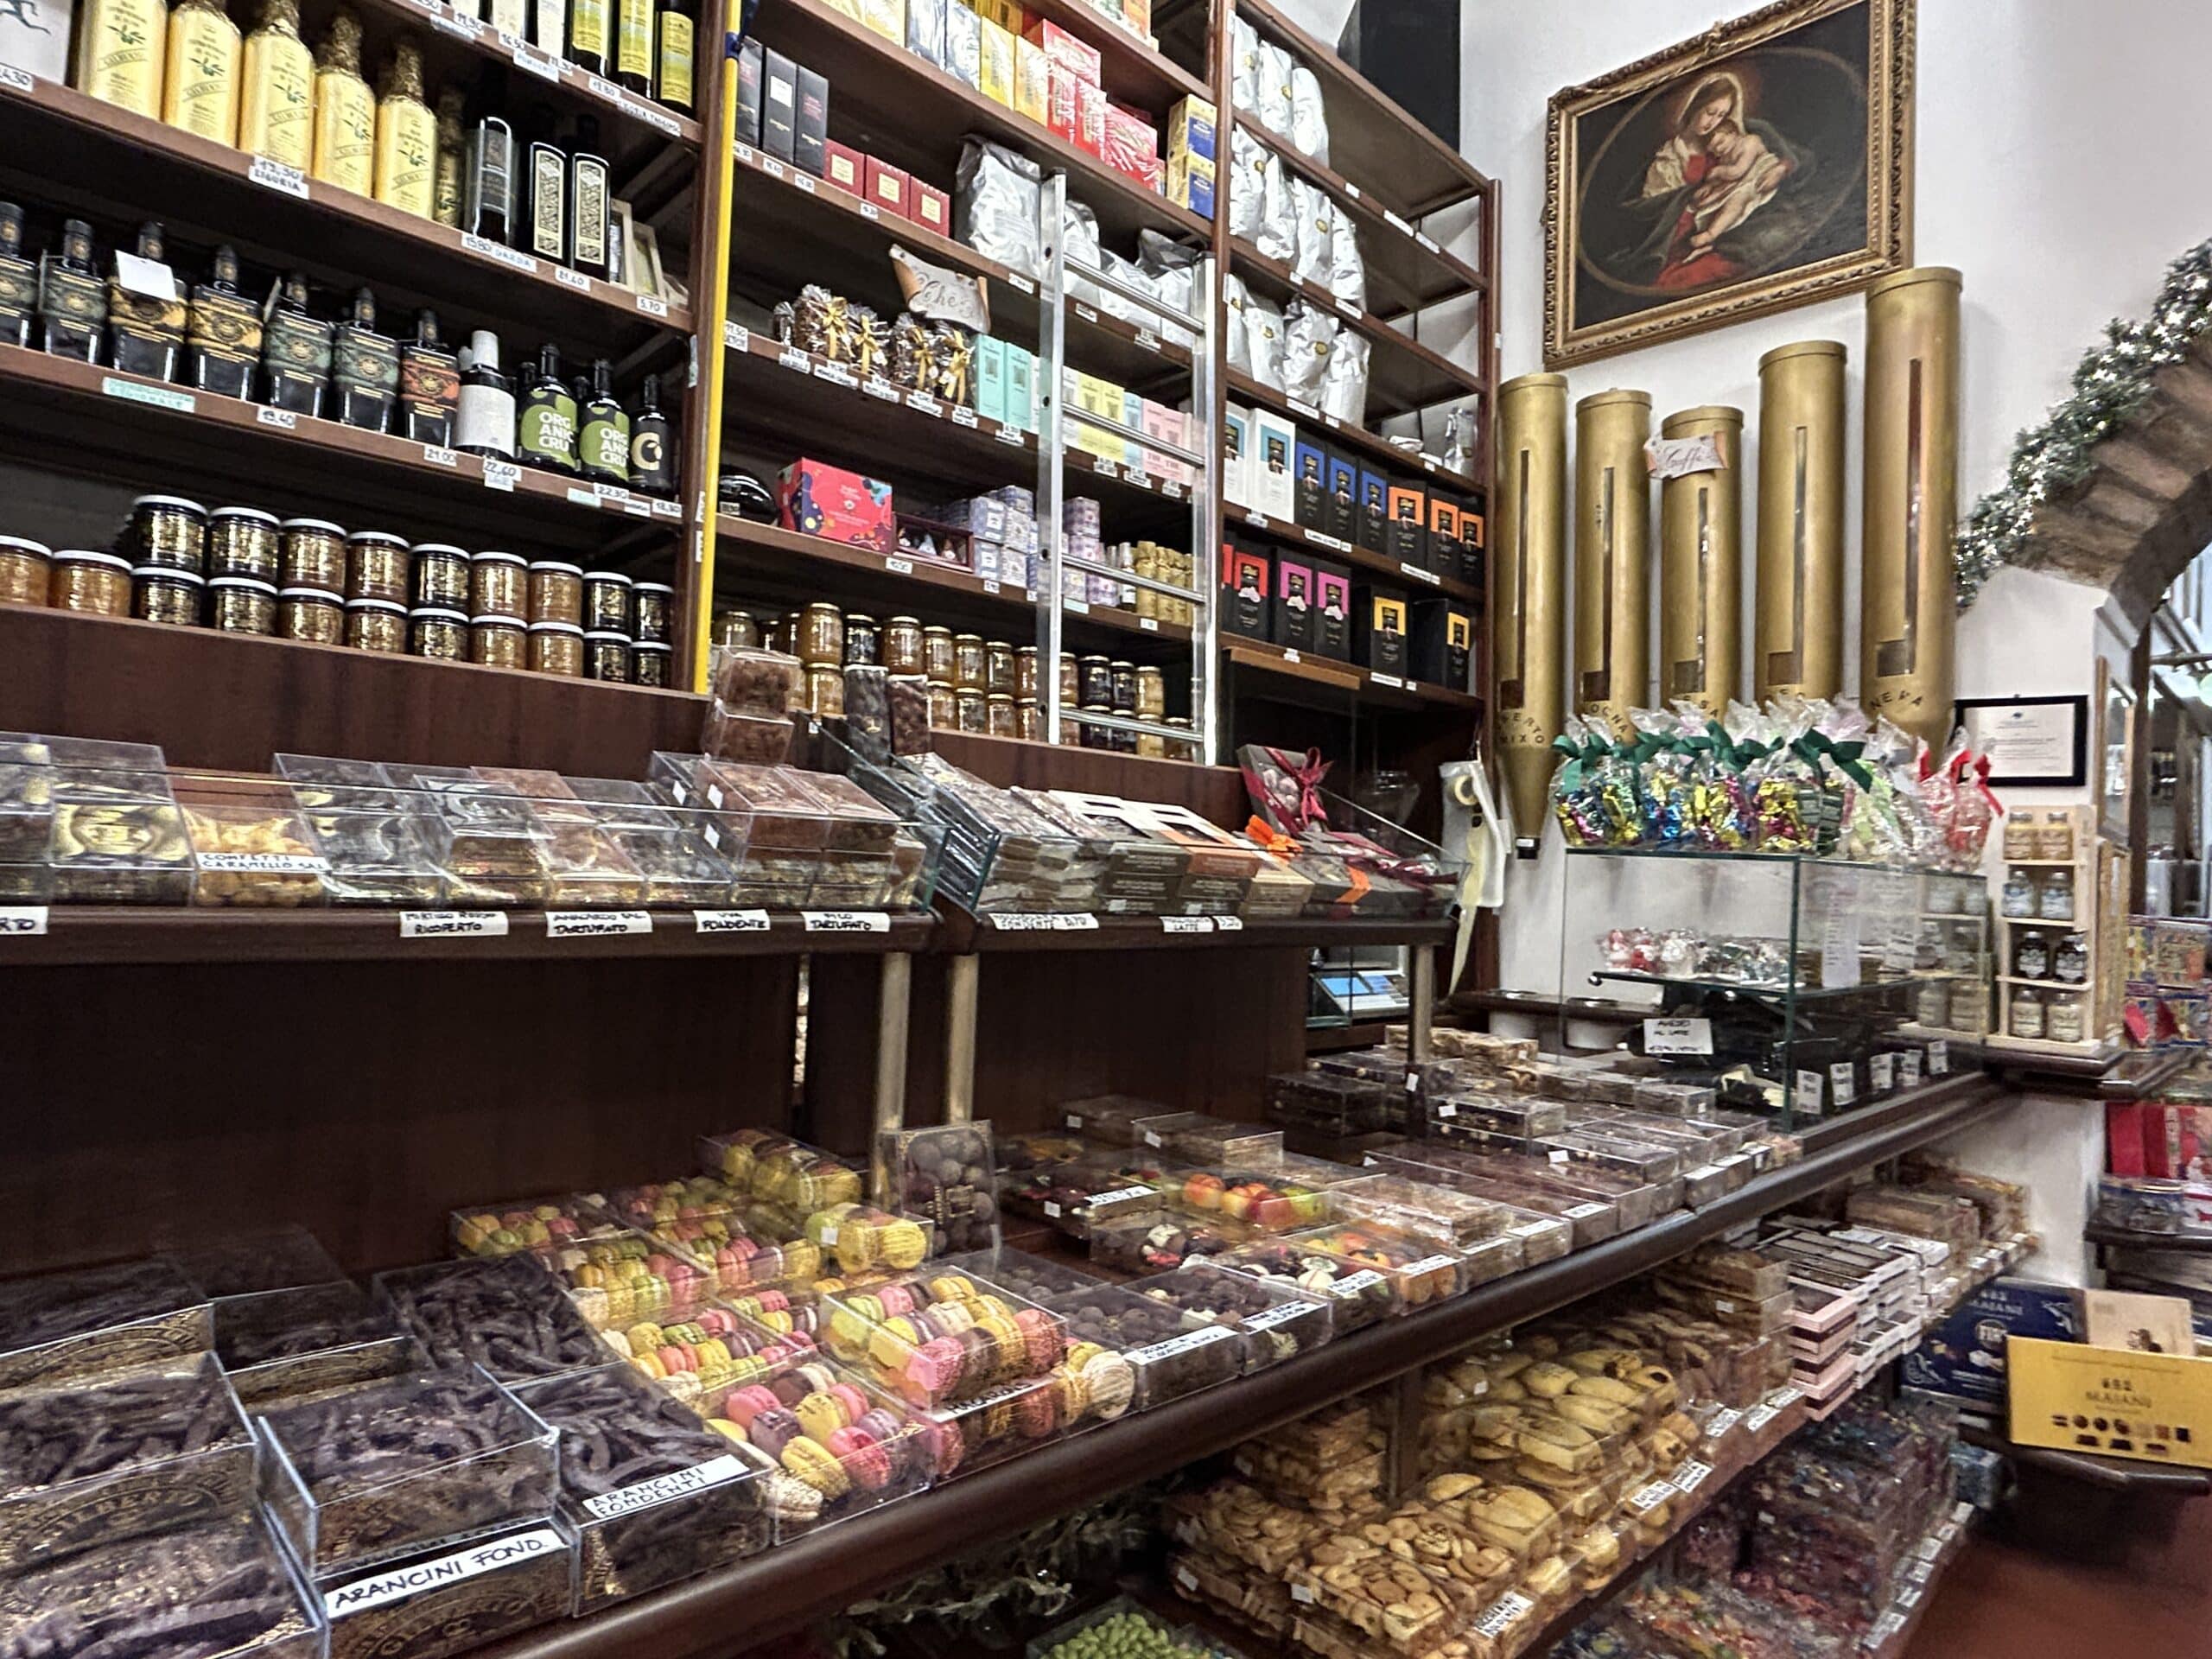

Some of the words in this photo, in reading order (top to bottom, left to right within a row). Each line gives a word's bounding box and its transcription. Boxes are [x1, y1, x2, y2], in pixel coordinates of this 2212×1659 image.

[539, 411, 572, 430] ORG
[539, 435, 570, 453] CRU
[600, 427, 629, 446] ORG
[600, 450, 627, 467] CRU
[202, 861, 294, 871] CARAMELLO
[415, 921, 484, 935] RICOPERTO
[553, 922, 629, 934] TARTUFATO
[702, 918, 766, 931] FONDENTE
[810, 920, 872, 931] TARTUFATO
[1173, 922, 1200, 931] LATTE
[590, 1466, 706, 1509] ARANCINI
[596, 1476, 708, 1518] FONDENTI
[334, 1560, 465, 1609] ARANCINI
